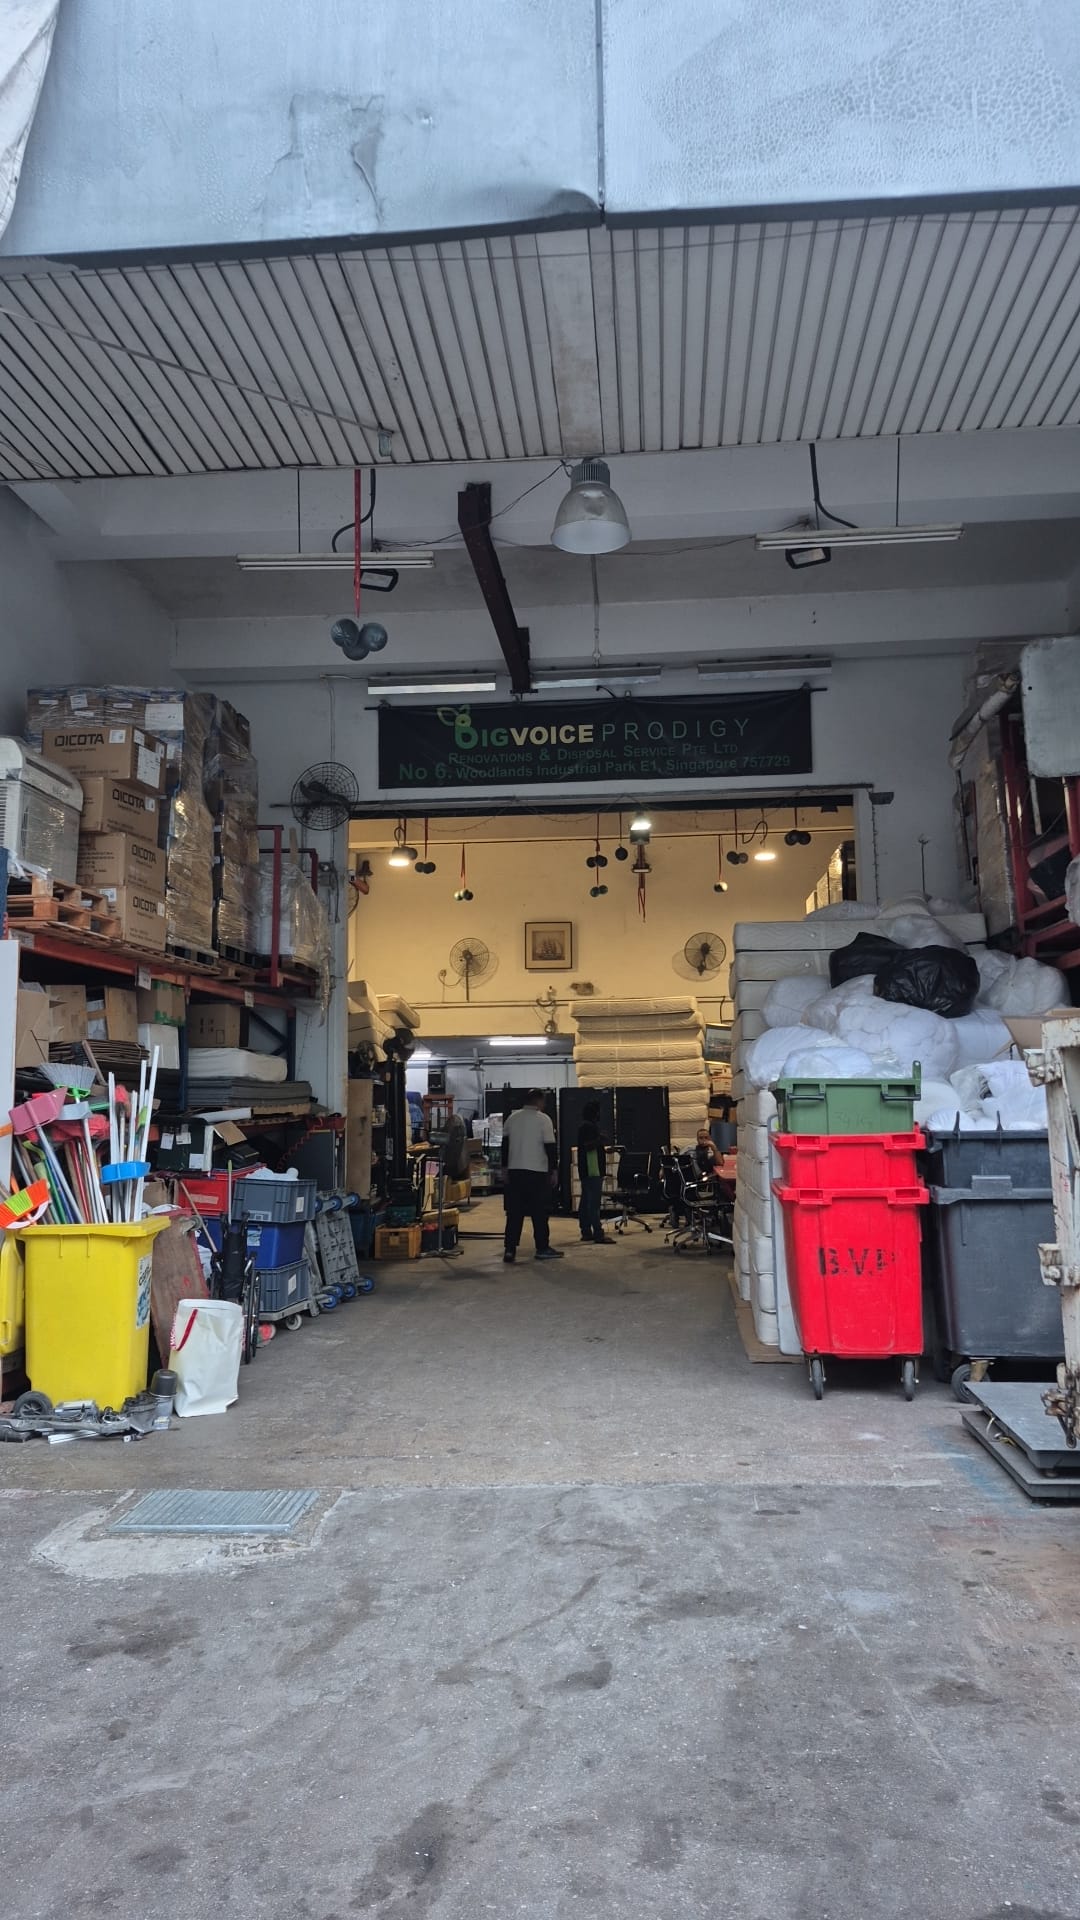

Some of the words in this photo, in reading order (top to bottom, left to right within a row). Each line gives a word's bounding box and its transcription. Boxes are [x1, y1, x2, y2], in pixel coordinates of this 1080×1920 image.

[602, 718, 751, 742] PRODIGY
[538, 748, 551, 761] &
[398, 762, 428, 781] No
[455, 765, 533, 779] Woodlands
[537, 761, 601, 777] Industrial
[604, 760, 635, 773] Park
[666, 757, 737, 774] Singapore
[741, 754, 791, 769] 757729
